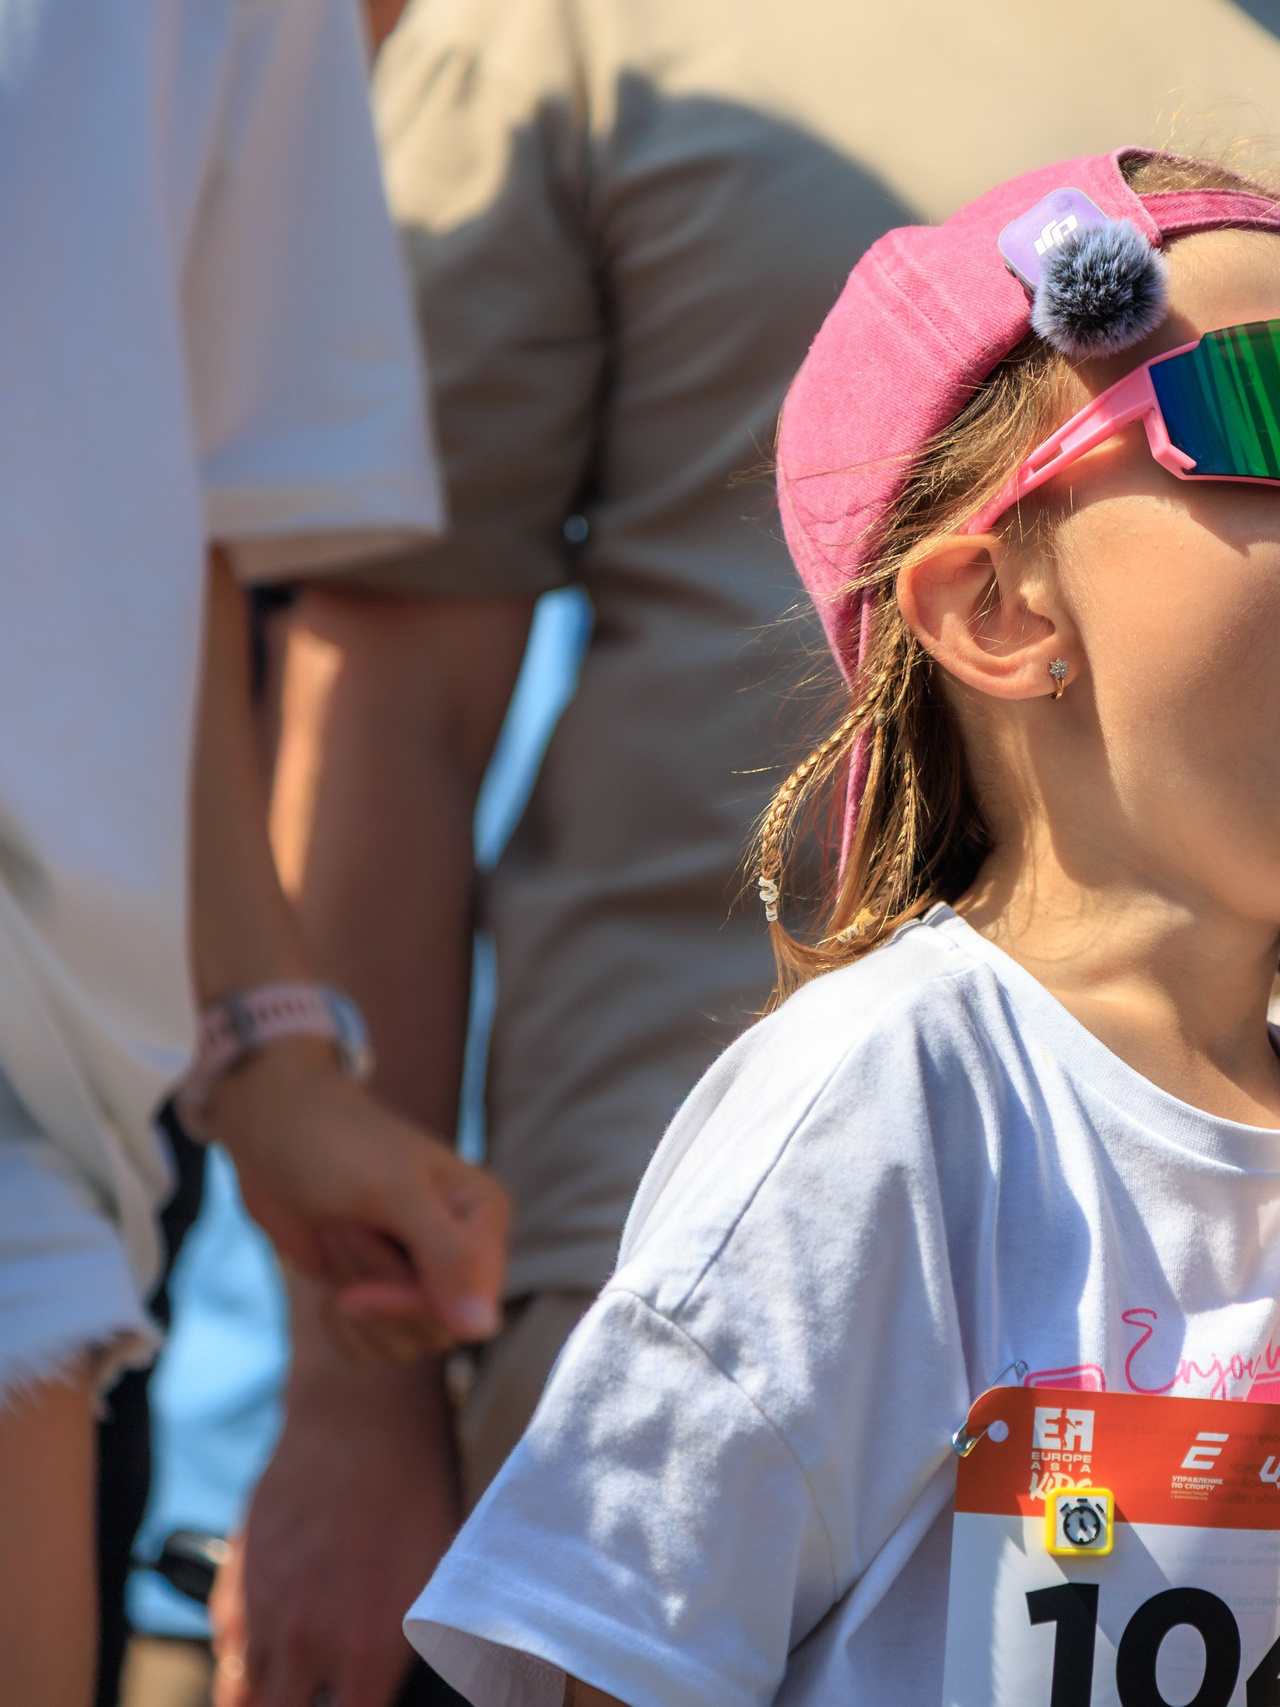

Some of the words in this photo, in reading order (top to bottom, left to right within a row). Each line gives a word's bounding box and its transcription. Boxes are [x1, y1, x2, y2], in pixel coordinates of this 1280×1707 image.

[1031, 1451, 1092, 1463] EUROPE
[1031, 1461, 1091, 1473] ASIA
[1171, 1476, 1223, 1485] УПРАВЛЕНИЕ
[1185, 1483, 1215, 1491] СПОРТУ
